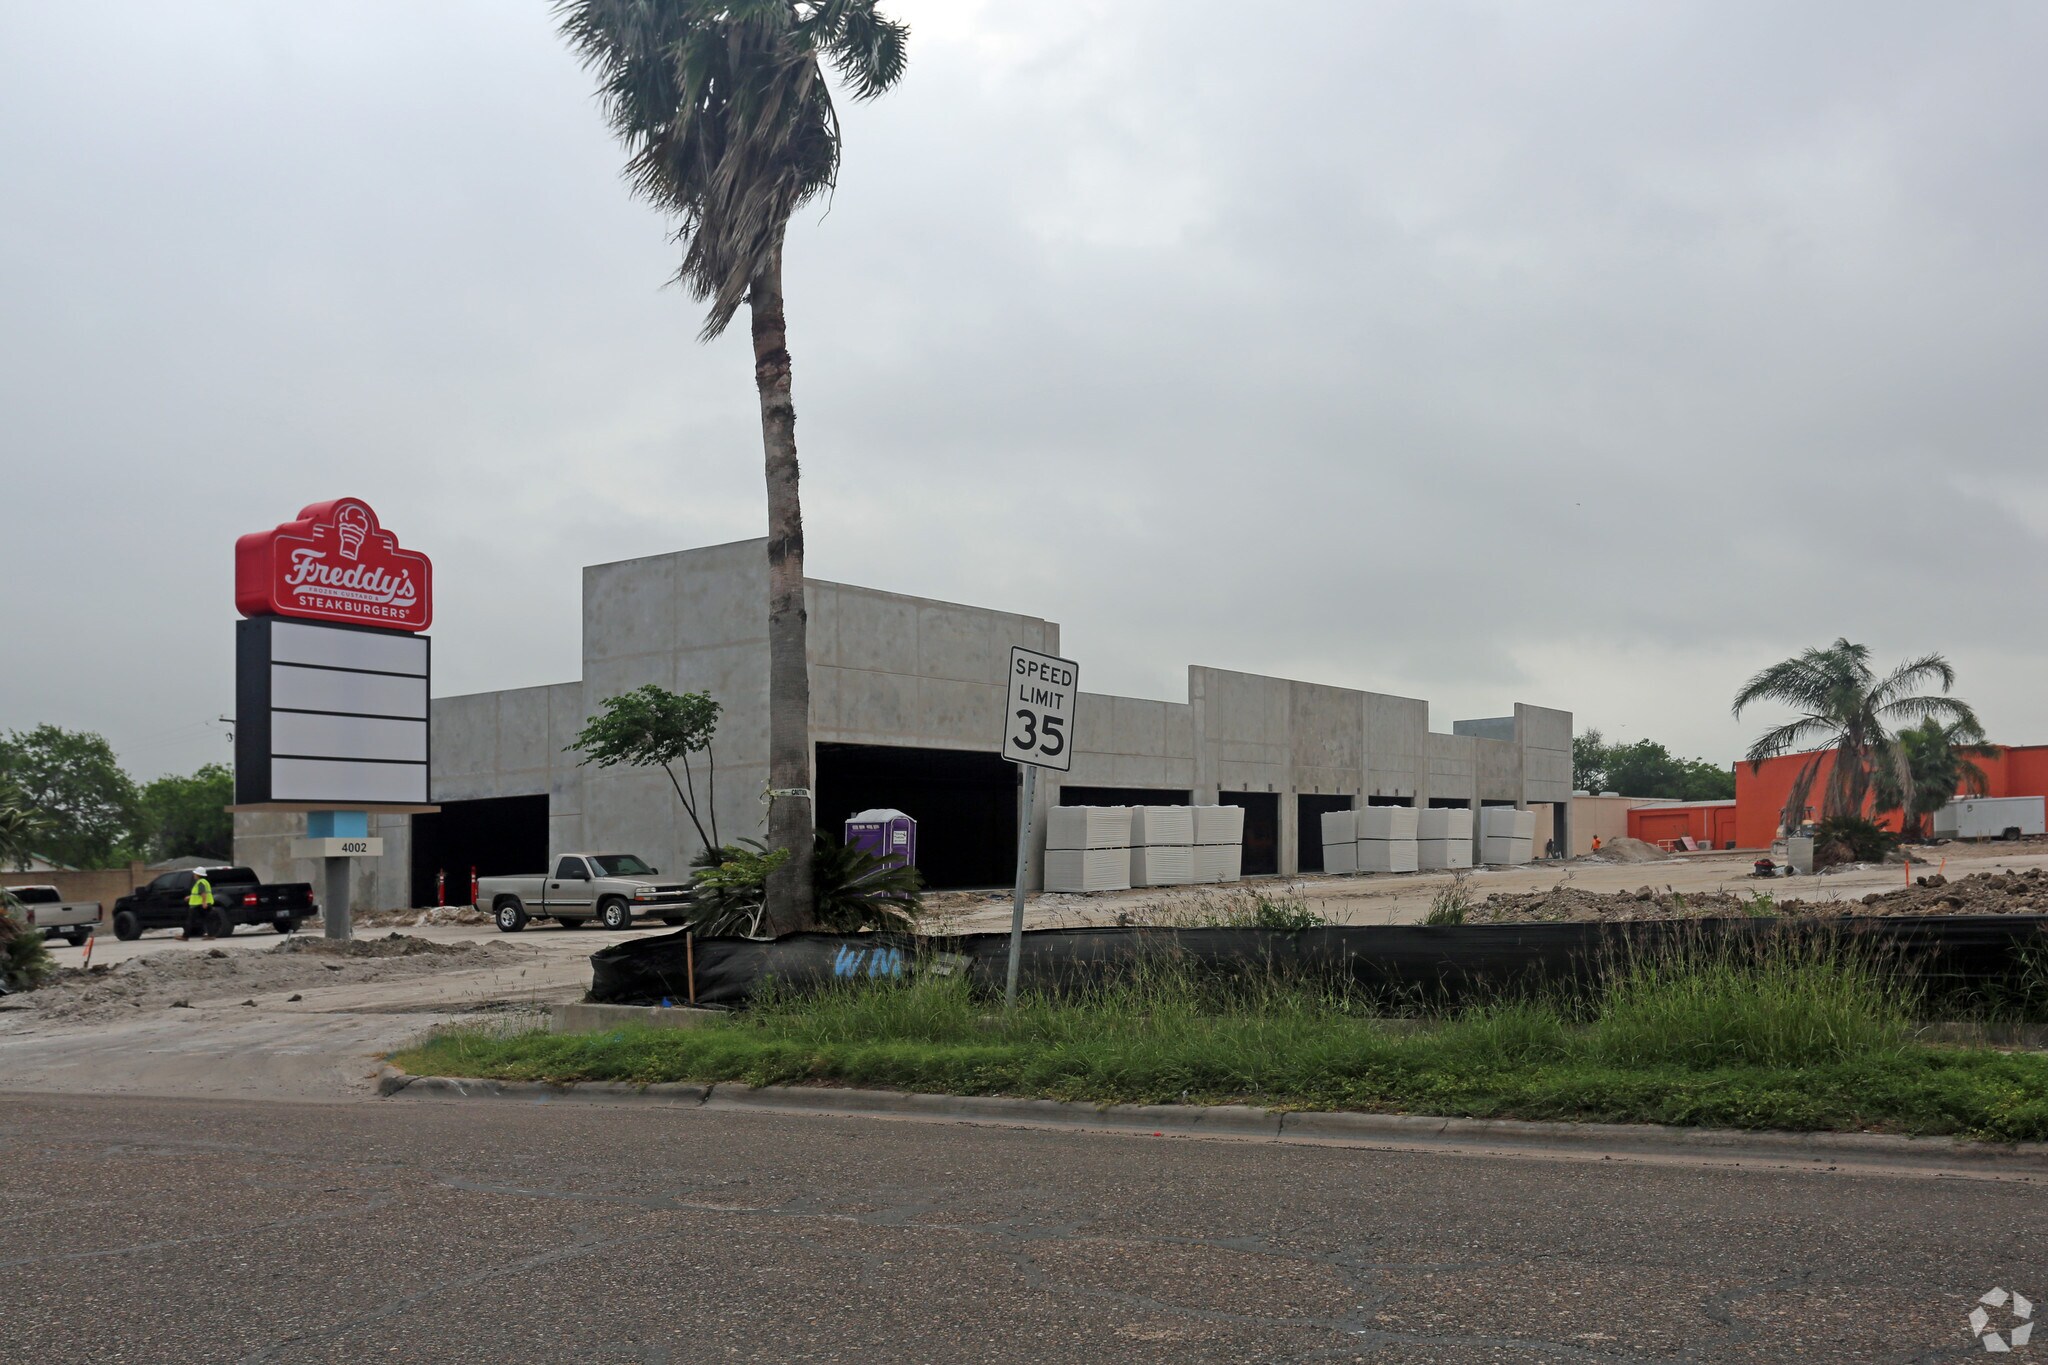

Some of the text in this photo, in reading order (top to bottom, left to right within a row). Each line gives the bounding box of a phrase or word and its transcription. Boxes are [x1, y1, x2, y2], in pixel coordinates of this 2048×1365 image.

[285, 548, 417, 607] Freddy's
[309, 587, 338, 596] FROZEN
[341, 590, 373, 601] CUSTARD
[1016, 658, 1072, 687] SPEED
[1020, 684, 1064, 710] LIMIT
[1012, 709, 1064, 756] 35
[341, 842, 367, 853] 4002
